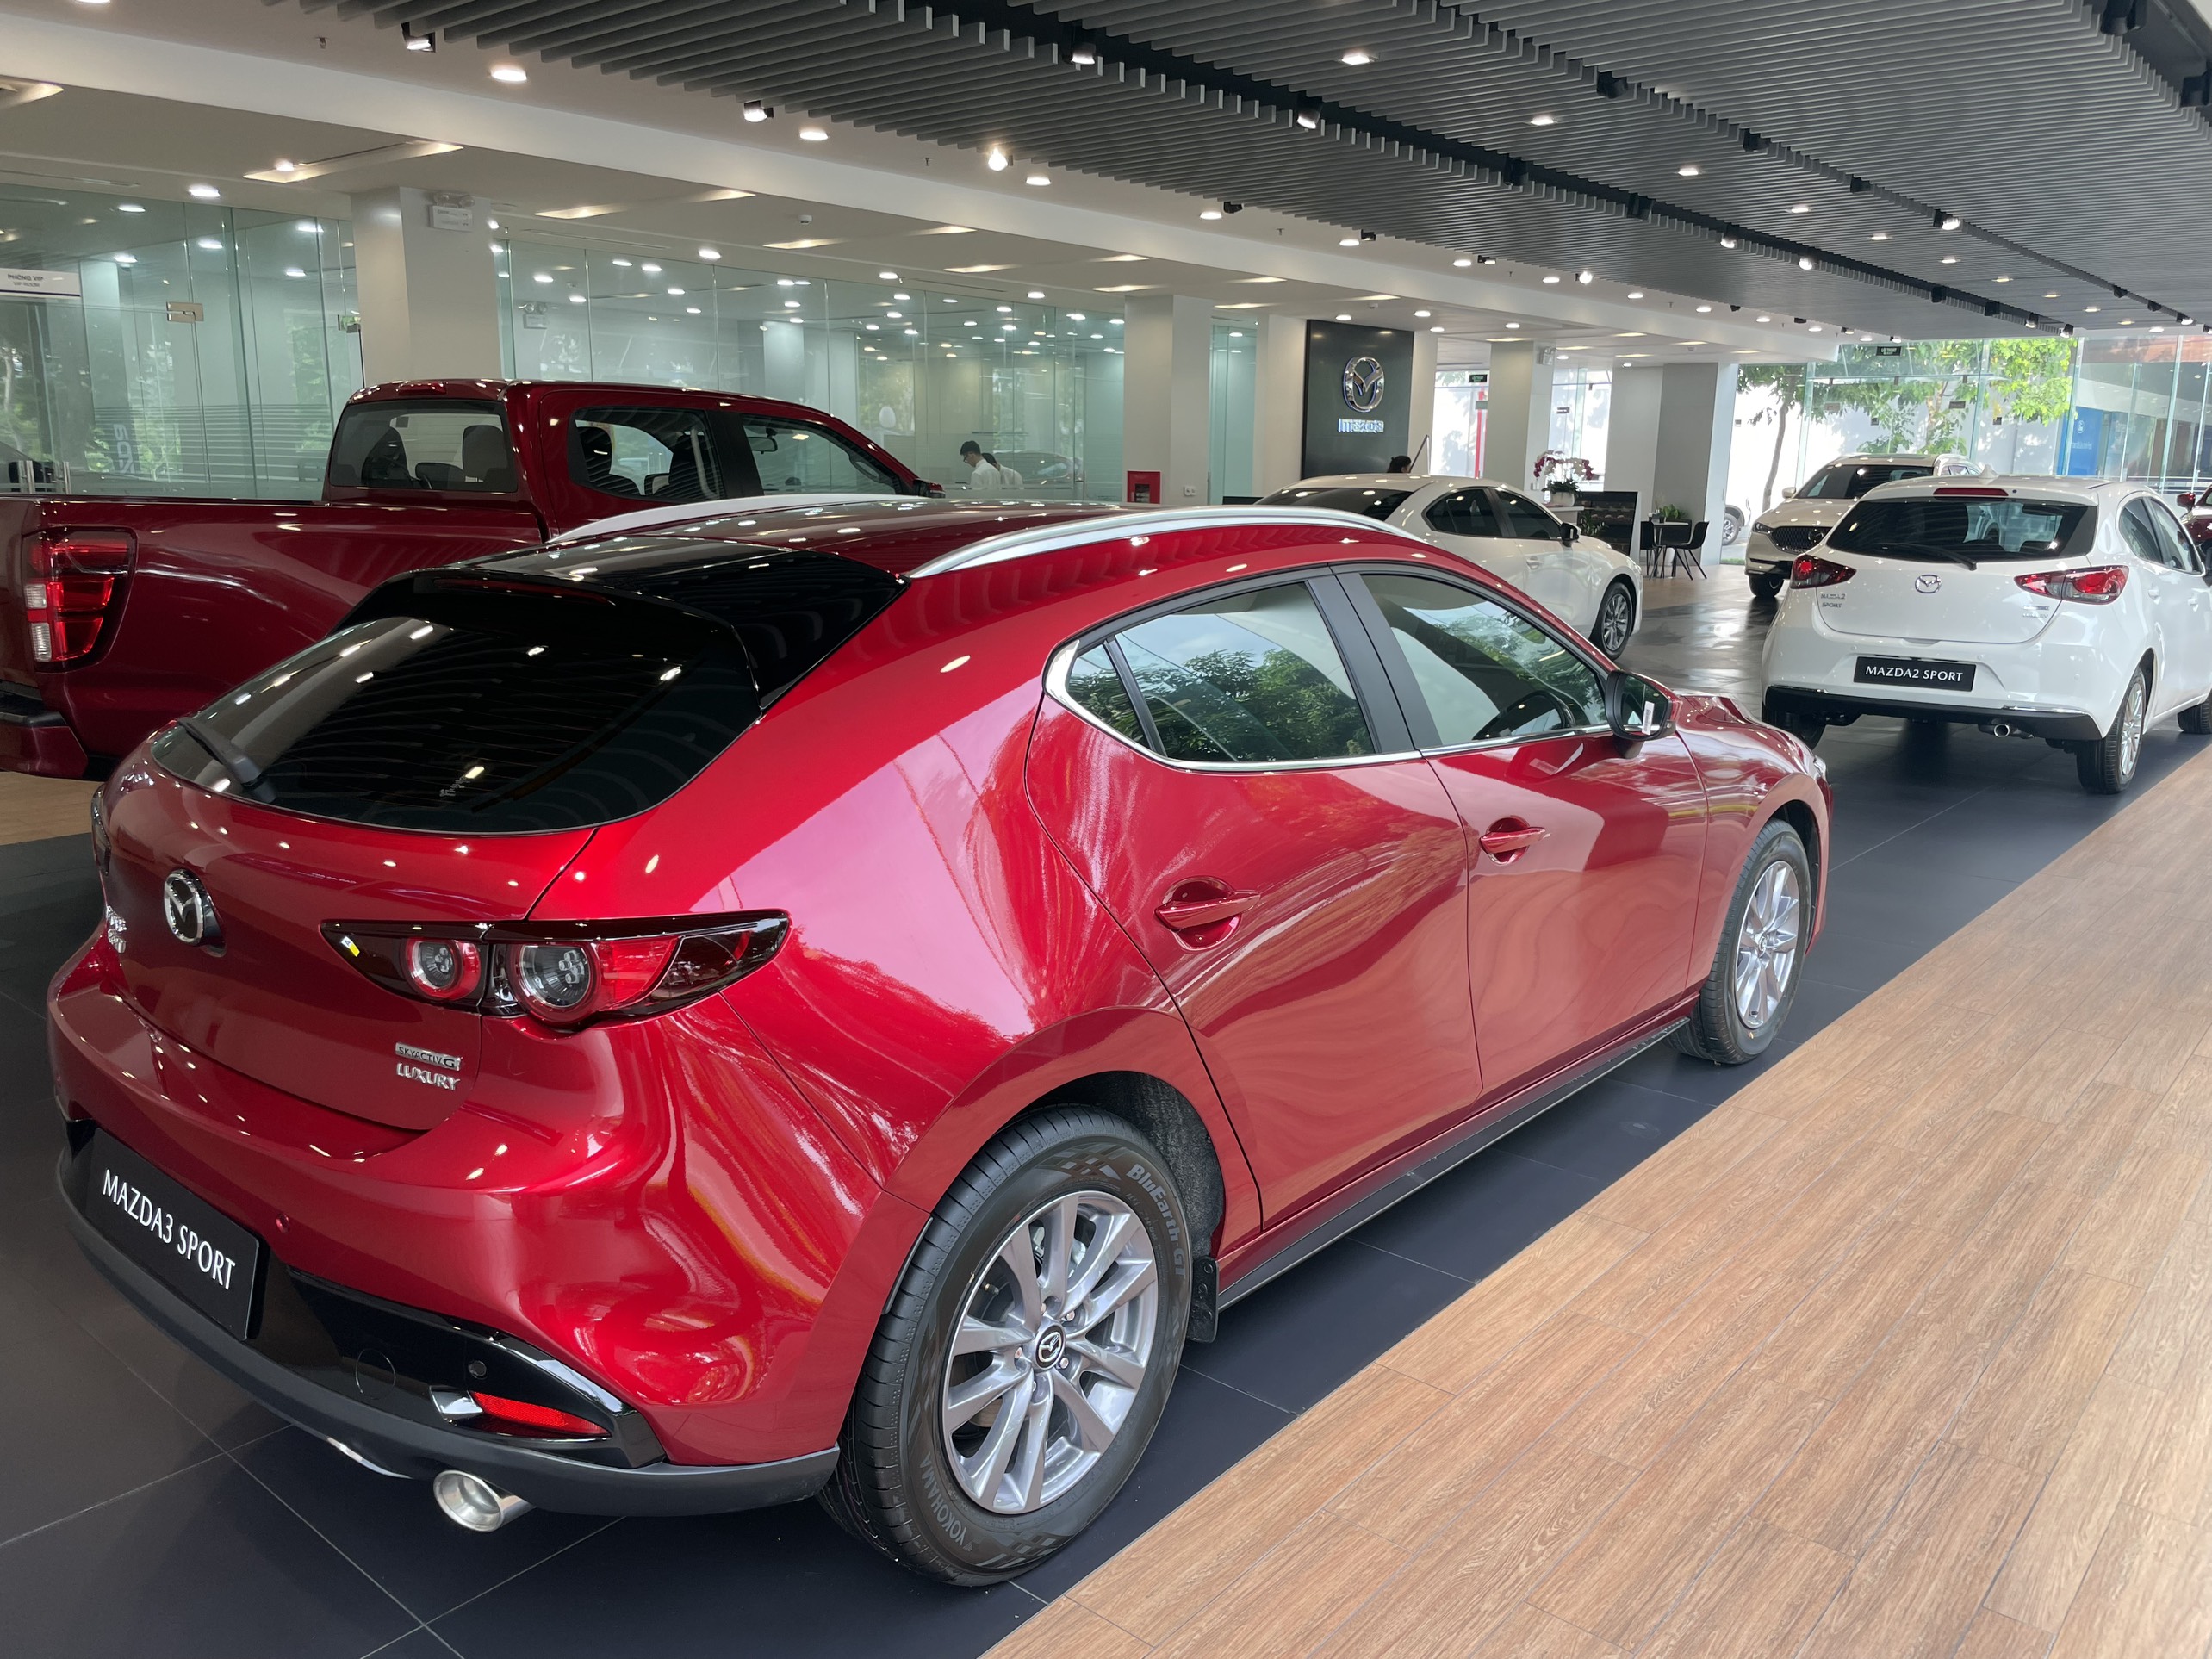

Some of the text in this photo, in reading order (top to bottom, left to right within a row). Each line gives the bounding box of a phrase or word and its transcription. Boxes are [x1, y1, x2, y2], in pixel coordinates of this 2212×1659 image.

[1865, 666, 1964, 682] MAZDA2 SPORT
[396, 1062, 461, 1091] LUXURY
[103, 1169, 237, 1290] MAZDA3 SPORT
[920, 1451, 967, 1546] YOKOHAMA
